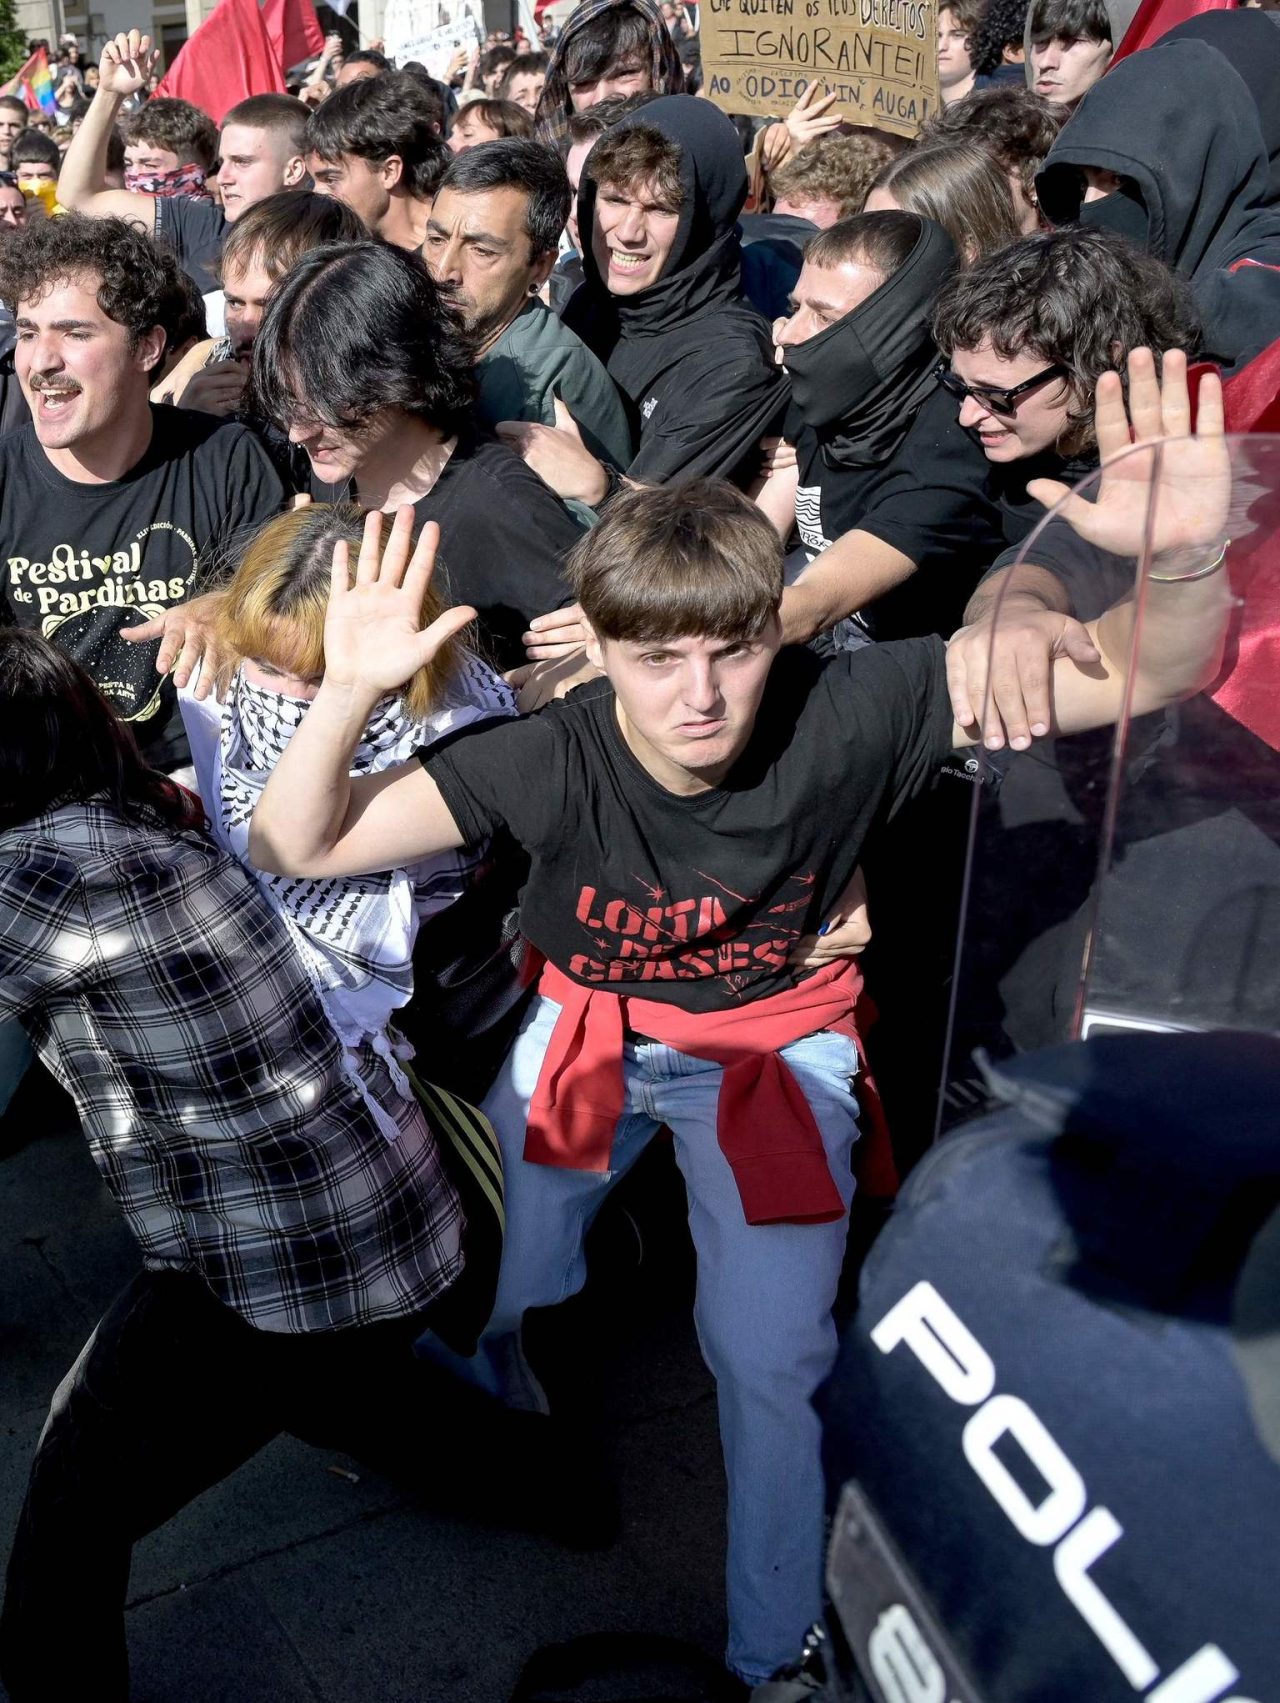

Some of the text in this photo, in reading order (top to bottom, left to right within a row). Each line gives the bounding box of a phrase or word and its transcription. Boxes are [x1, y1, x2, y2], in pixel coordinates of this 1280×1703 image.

[806, 0, 820, 17] OS
[709, 74, 731, 97] AO
[746, 75, 808, 98] ODIO
[825, 83, 861, 104] NIN
[873, 87, 928, 121] AUGA!
[7, 542, 141, 585] Festival
[14, 574, 186, 615] de Pardiñas
[870, 1280, 1250, 1703] POLI
